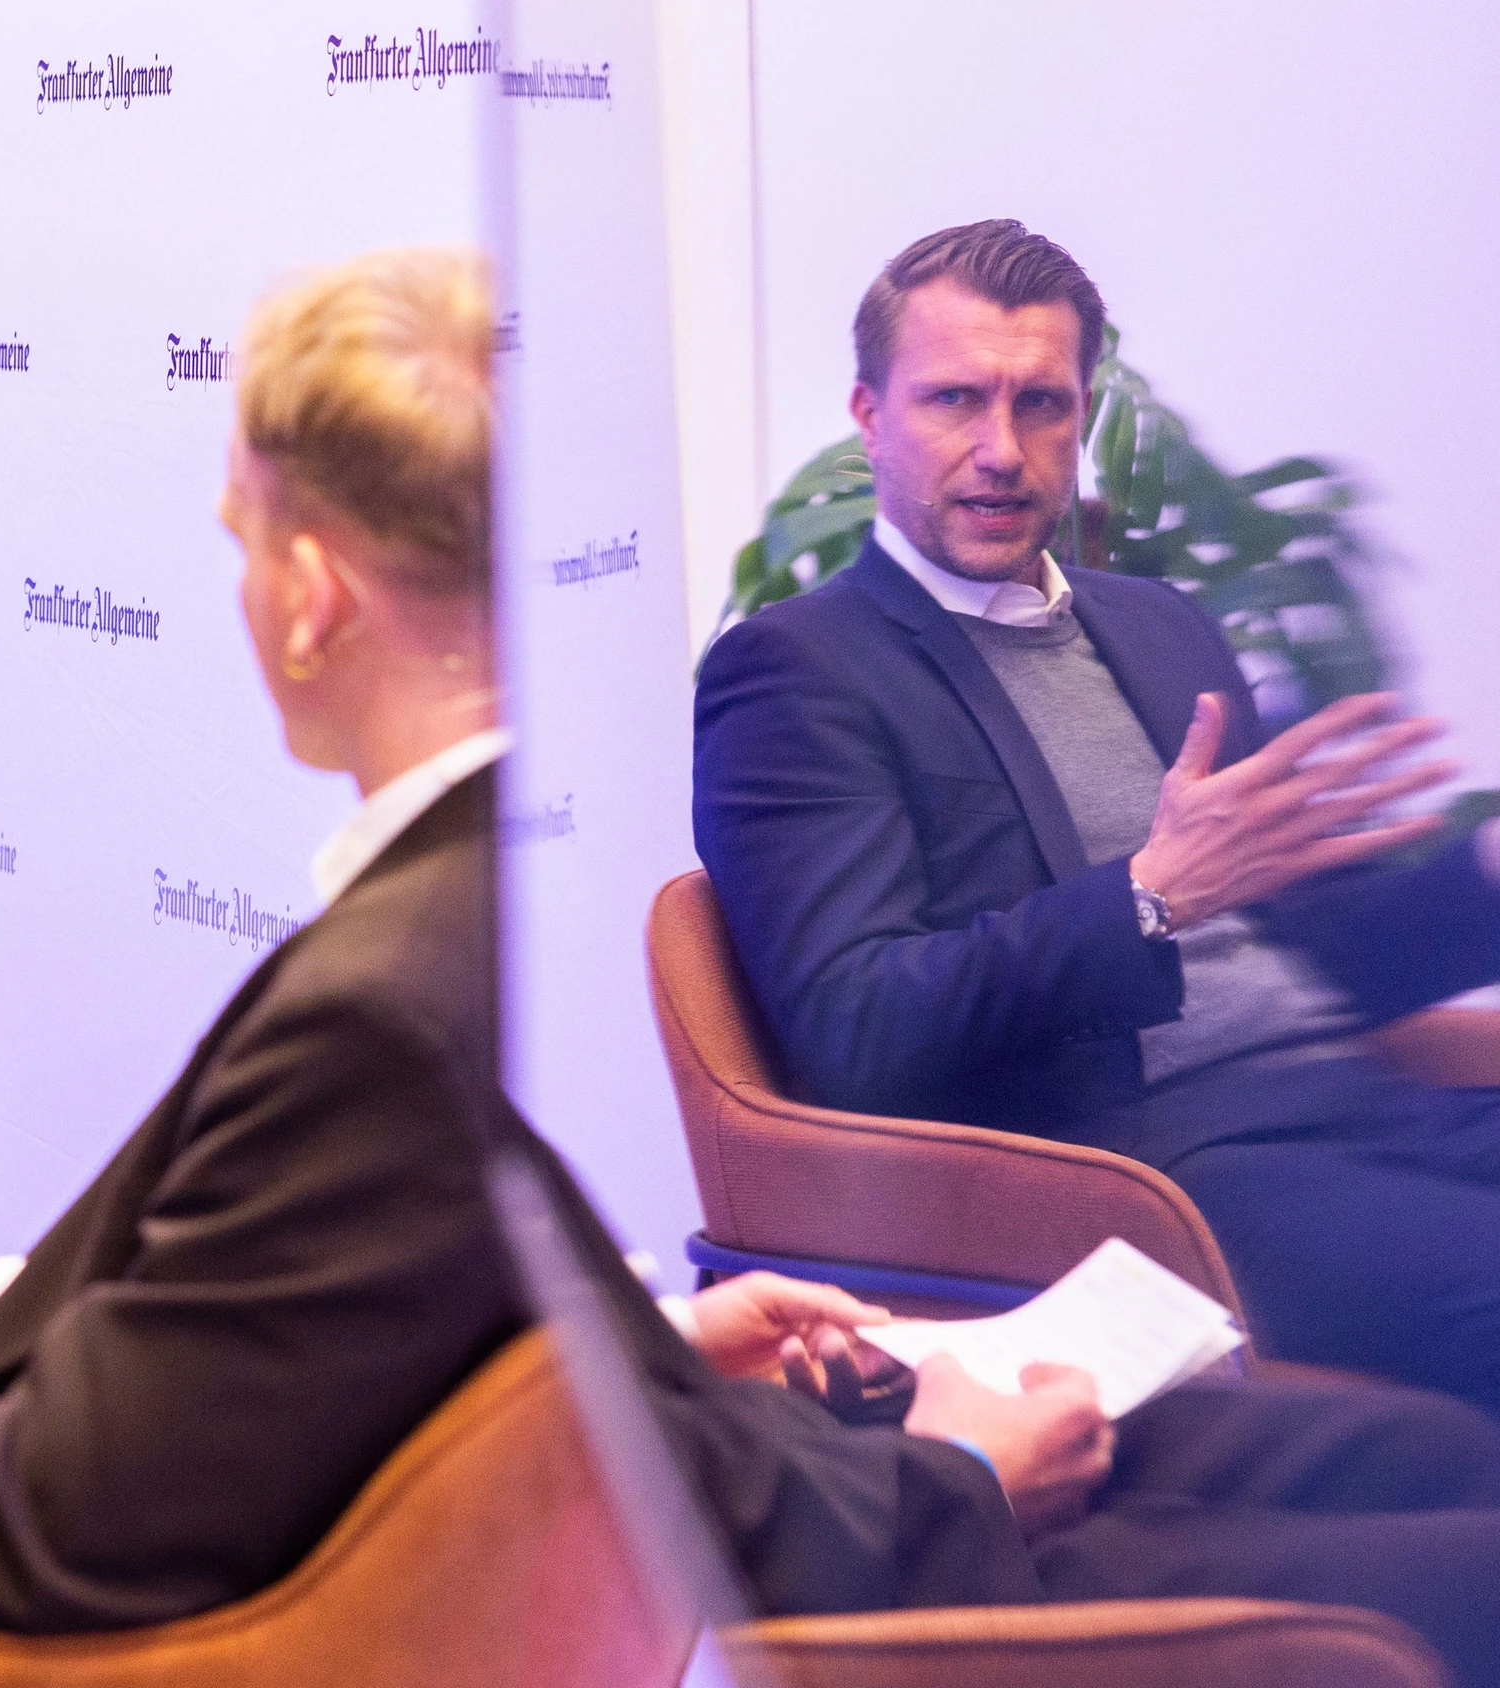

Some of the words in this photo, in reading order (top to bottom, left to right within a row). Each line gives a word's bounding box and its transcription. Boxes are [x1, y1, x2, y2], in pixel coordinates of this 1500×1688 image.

[36, 59, 104, 115] Frankfurter
[104, 53, 173, 110] Allgemeine
[327, 34, 412, 97] Frankfurter
[412, 26, 501, 91] Allgemeine
[166, 332, 237, 392] Frankfurte
[24, 577, 91, 635] Frankfurter
[91, 586, 160, 646] Allgemeine
[153, 867, 230, 934] Frankfurter
[229, 887, 307, 952] Allgemein
